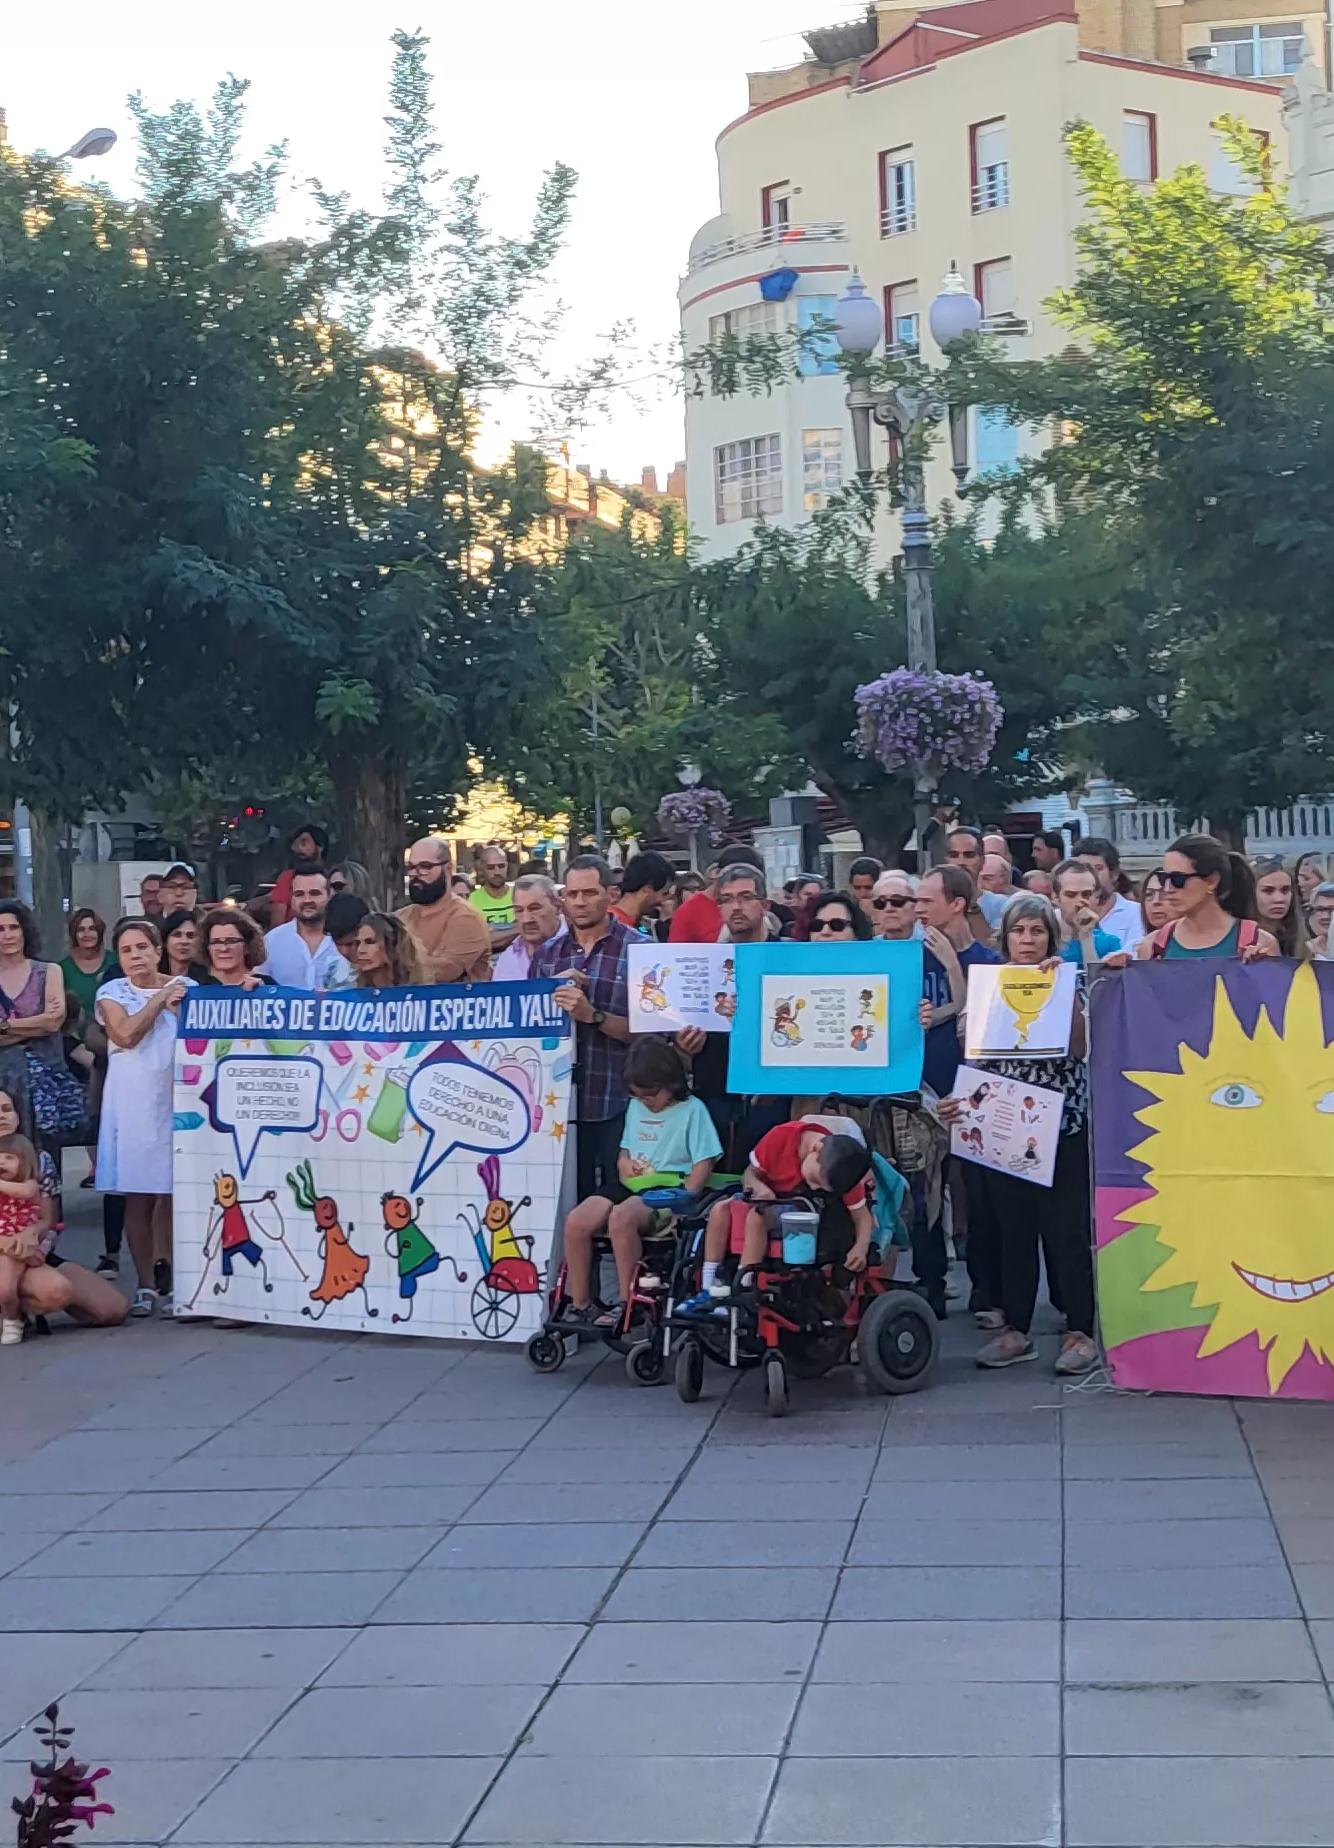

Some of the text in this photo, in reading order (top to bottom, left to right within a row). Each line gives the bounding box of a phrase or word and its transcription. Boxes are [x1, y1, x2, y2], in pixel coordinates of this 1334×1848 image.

[184, 998, 287, 1031] AUXILIARES
[288, 998, 316, 1031] DE
[318, 993, 427, 1033] EDUCACIÓN
[428, 995, 515, 1032] ESPECIAL
